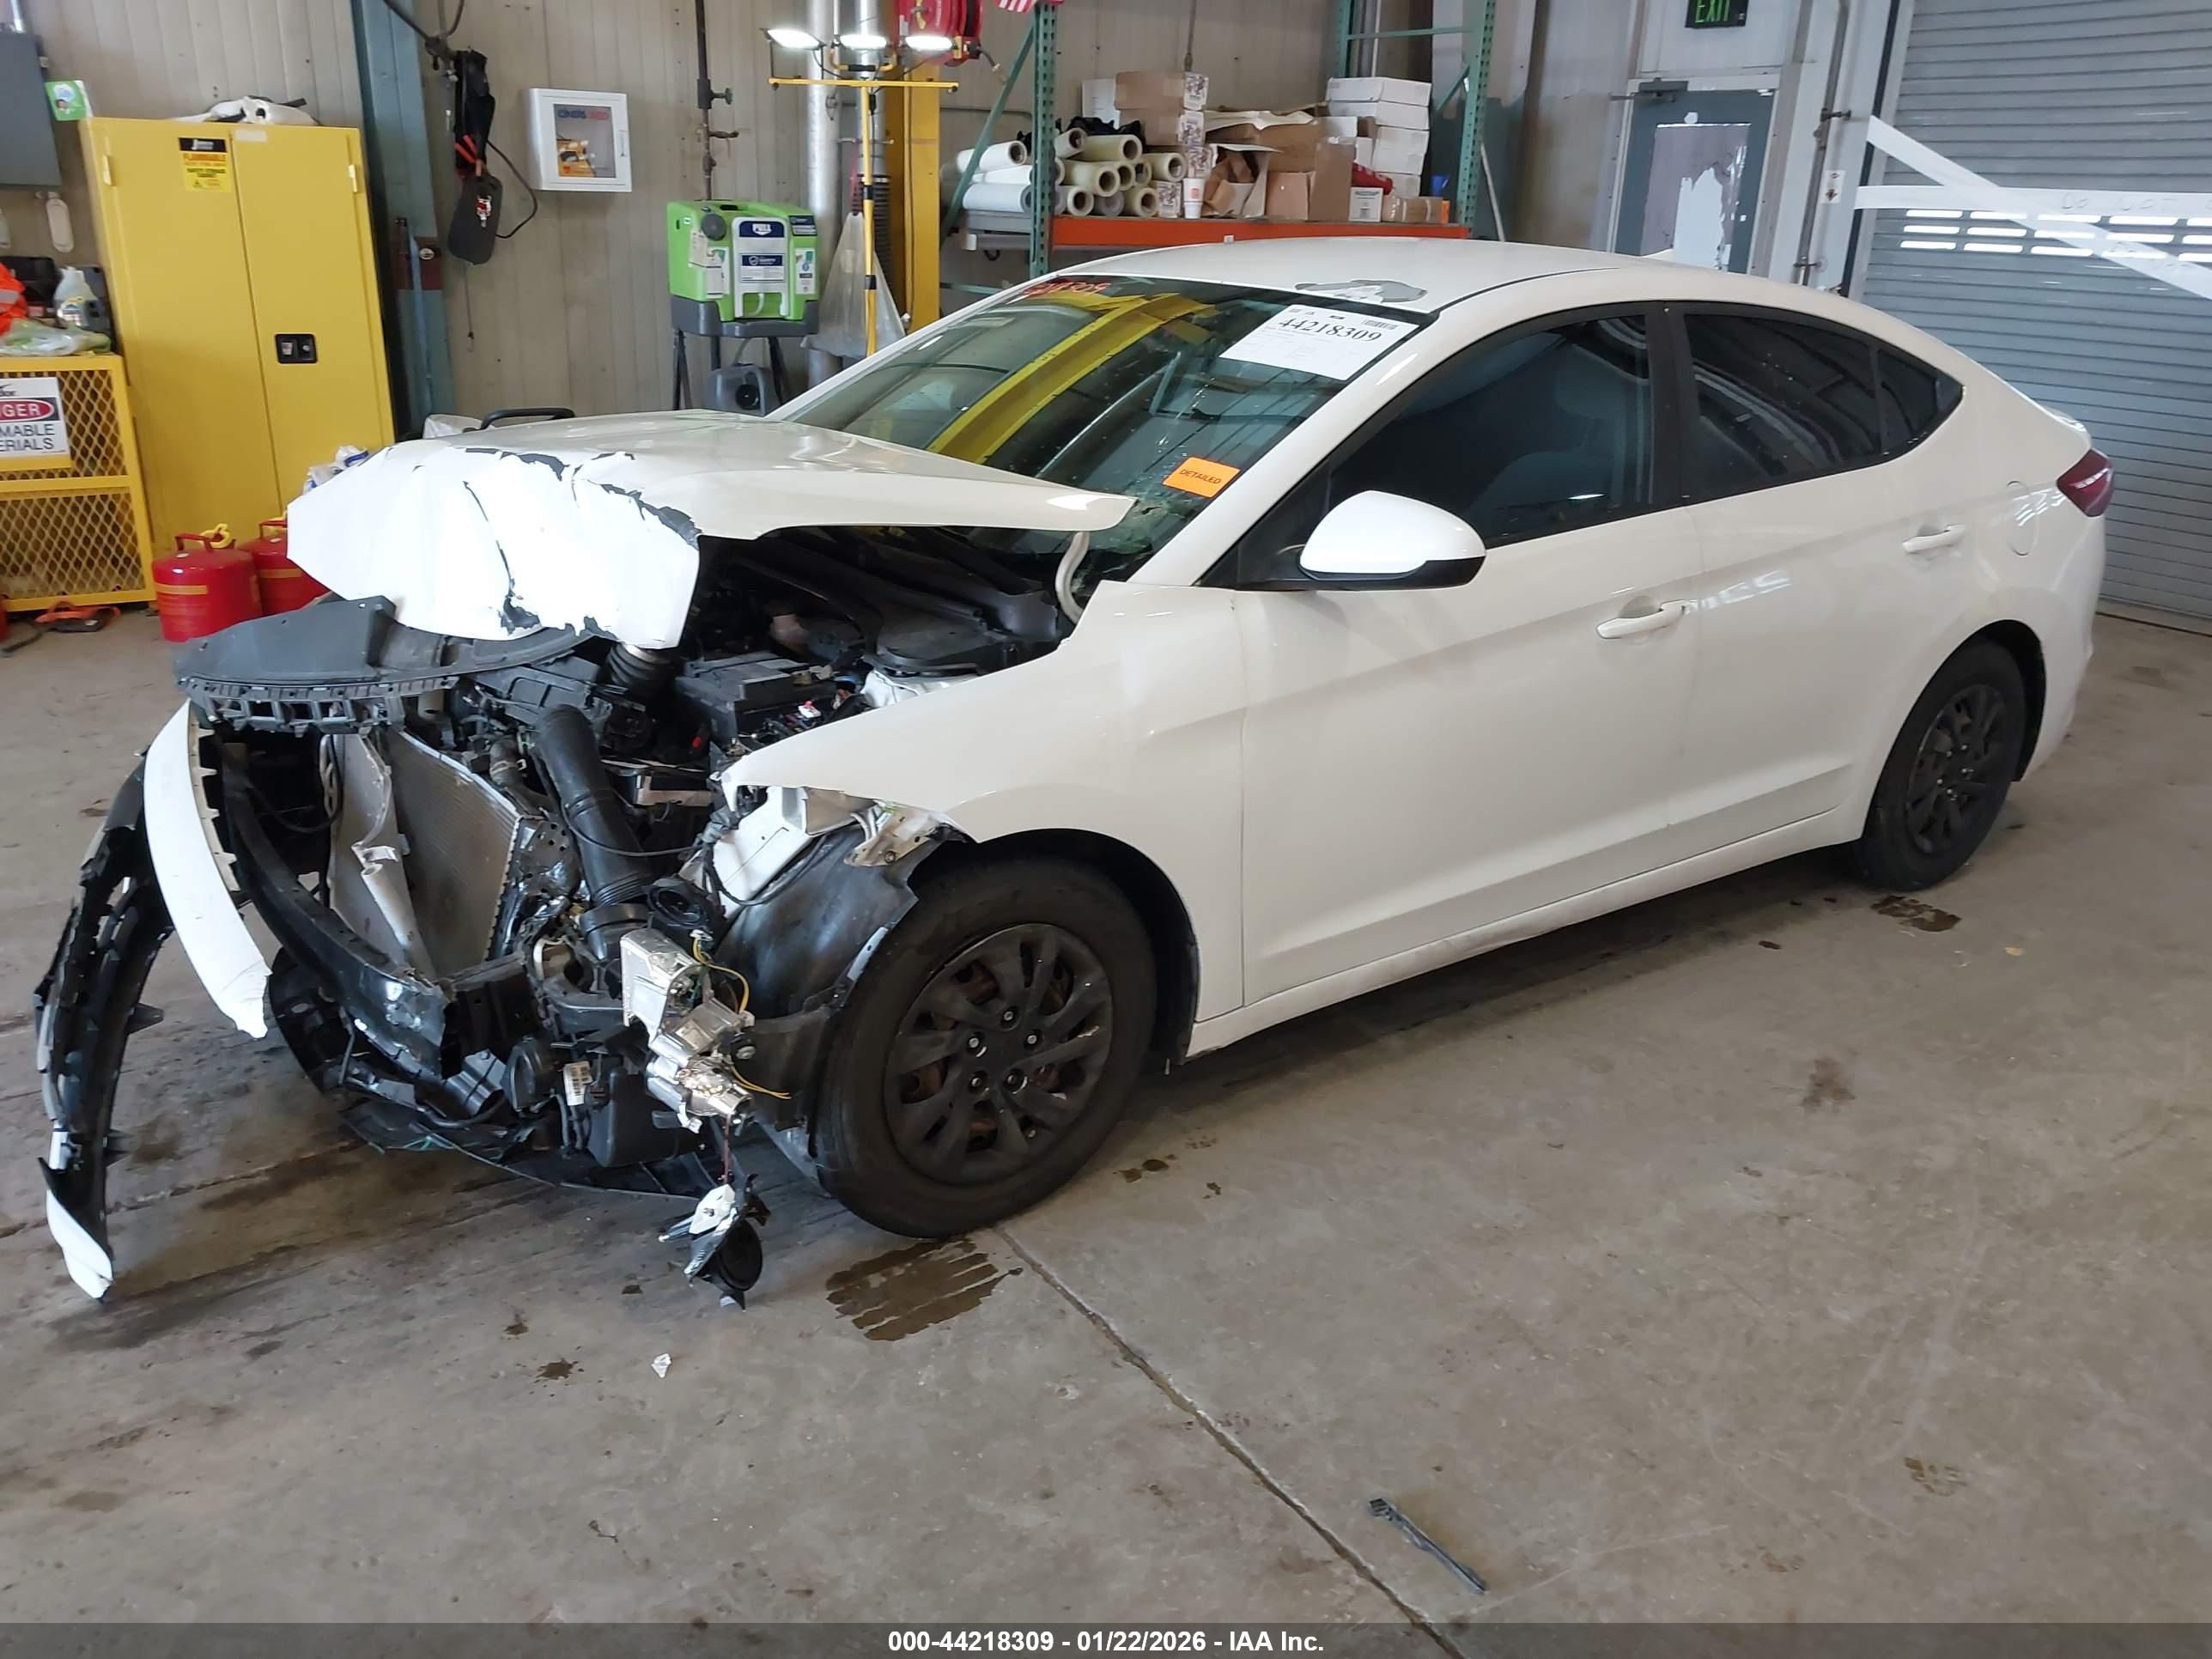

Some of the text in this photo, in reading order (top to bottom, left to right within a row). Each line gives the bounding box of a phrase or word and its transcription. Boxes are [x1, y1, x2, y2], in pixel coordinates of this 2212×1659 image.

[1279, 318, 1382, 342] 44218309
[0, 404, 40, 417] GER
[0, 423, 55, 437] MABLE
[0, 437, 55, 452] ERIALS
[1180, 469, 1222, 484] DETAILED
